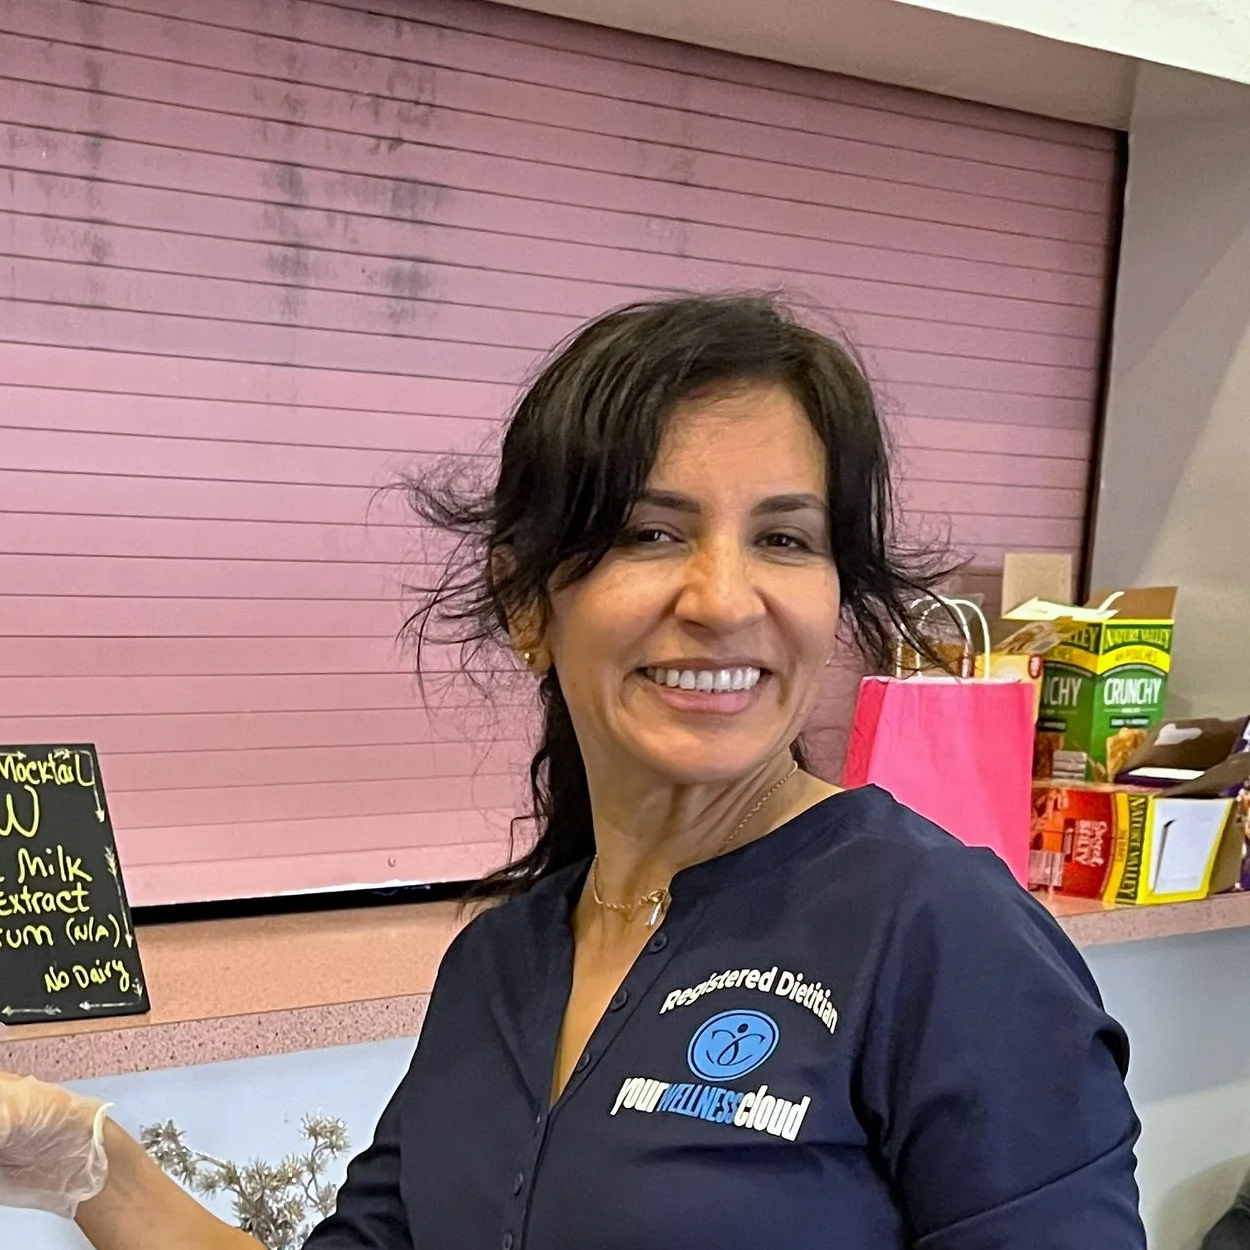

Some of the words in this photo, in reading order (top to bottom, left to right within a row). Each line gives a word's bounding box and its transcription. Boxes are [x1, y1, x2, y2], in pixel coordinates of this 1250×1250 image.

[1103, 677, 1162, 705] CRUNCHY
[17, 845, 93, 884] Milk
[44, 966, 70, 993] No
[74, 957, 131, 993] Dairy
[659, 966, 778, 1015] Registered
[778, 970, 839, 1035] Dietitian
[609, 1077, 812, 1142] yourWELLNESScloud
